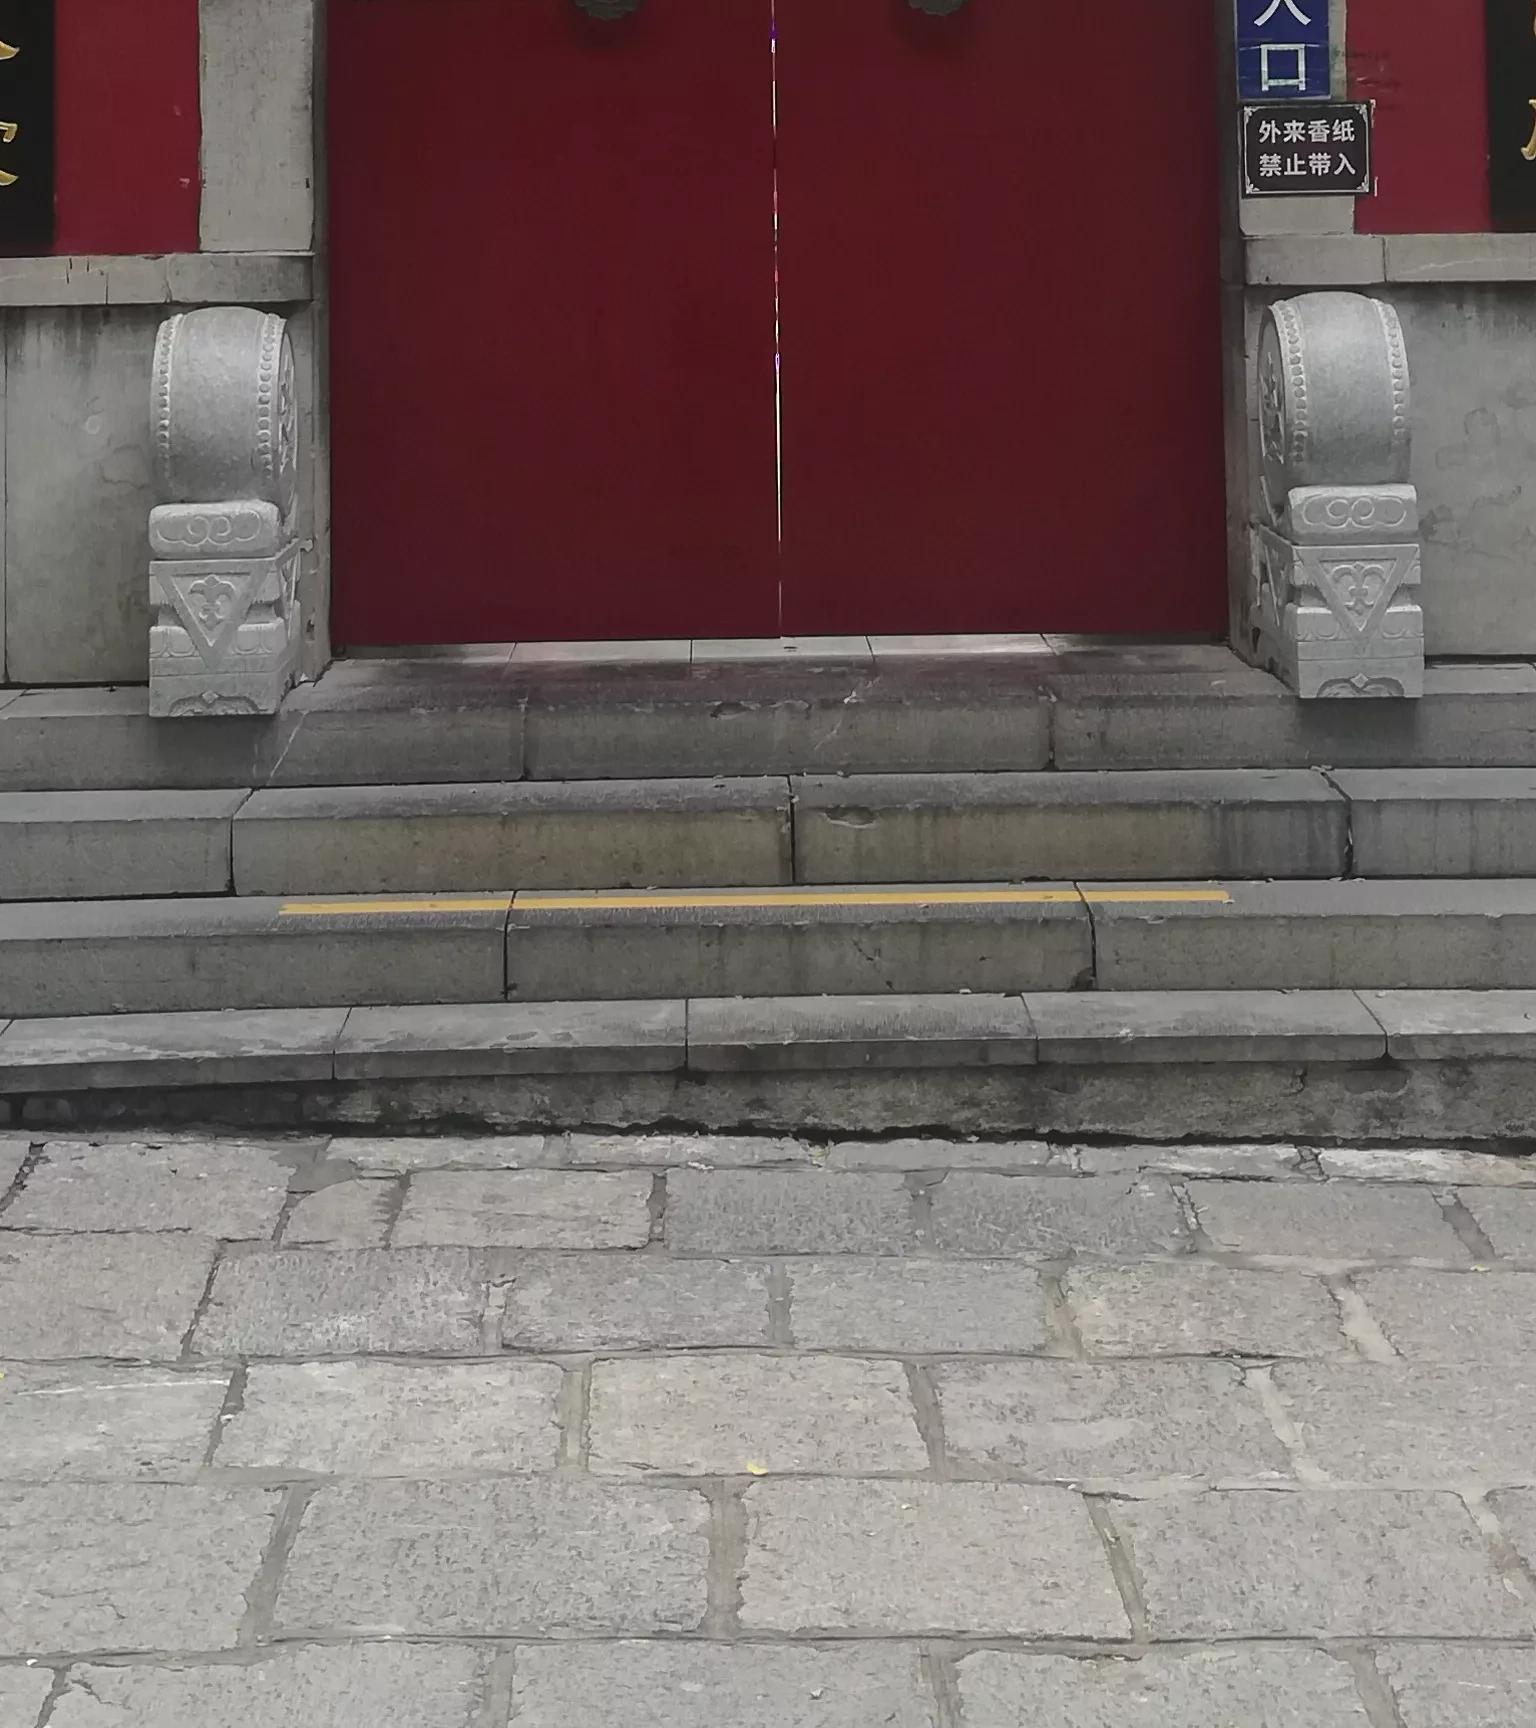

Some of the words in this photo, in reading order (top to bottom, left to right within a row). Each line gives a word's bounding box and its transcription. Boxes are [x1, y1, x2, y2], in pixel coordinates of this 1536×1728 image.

[1258, 119, 1356, 144] 外来香纸
[1258, 152, 1356, 177] 禁止带入
